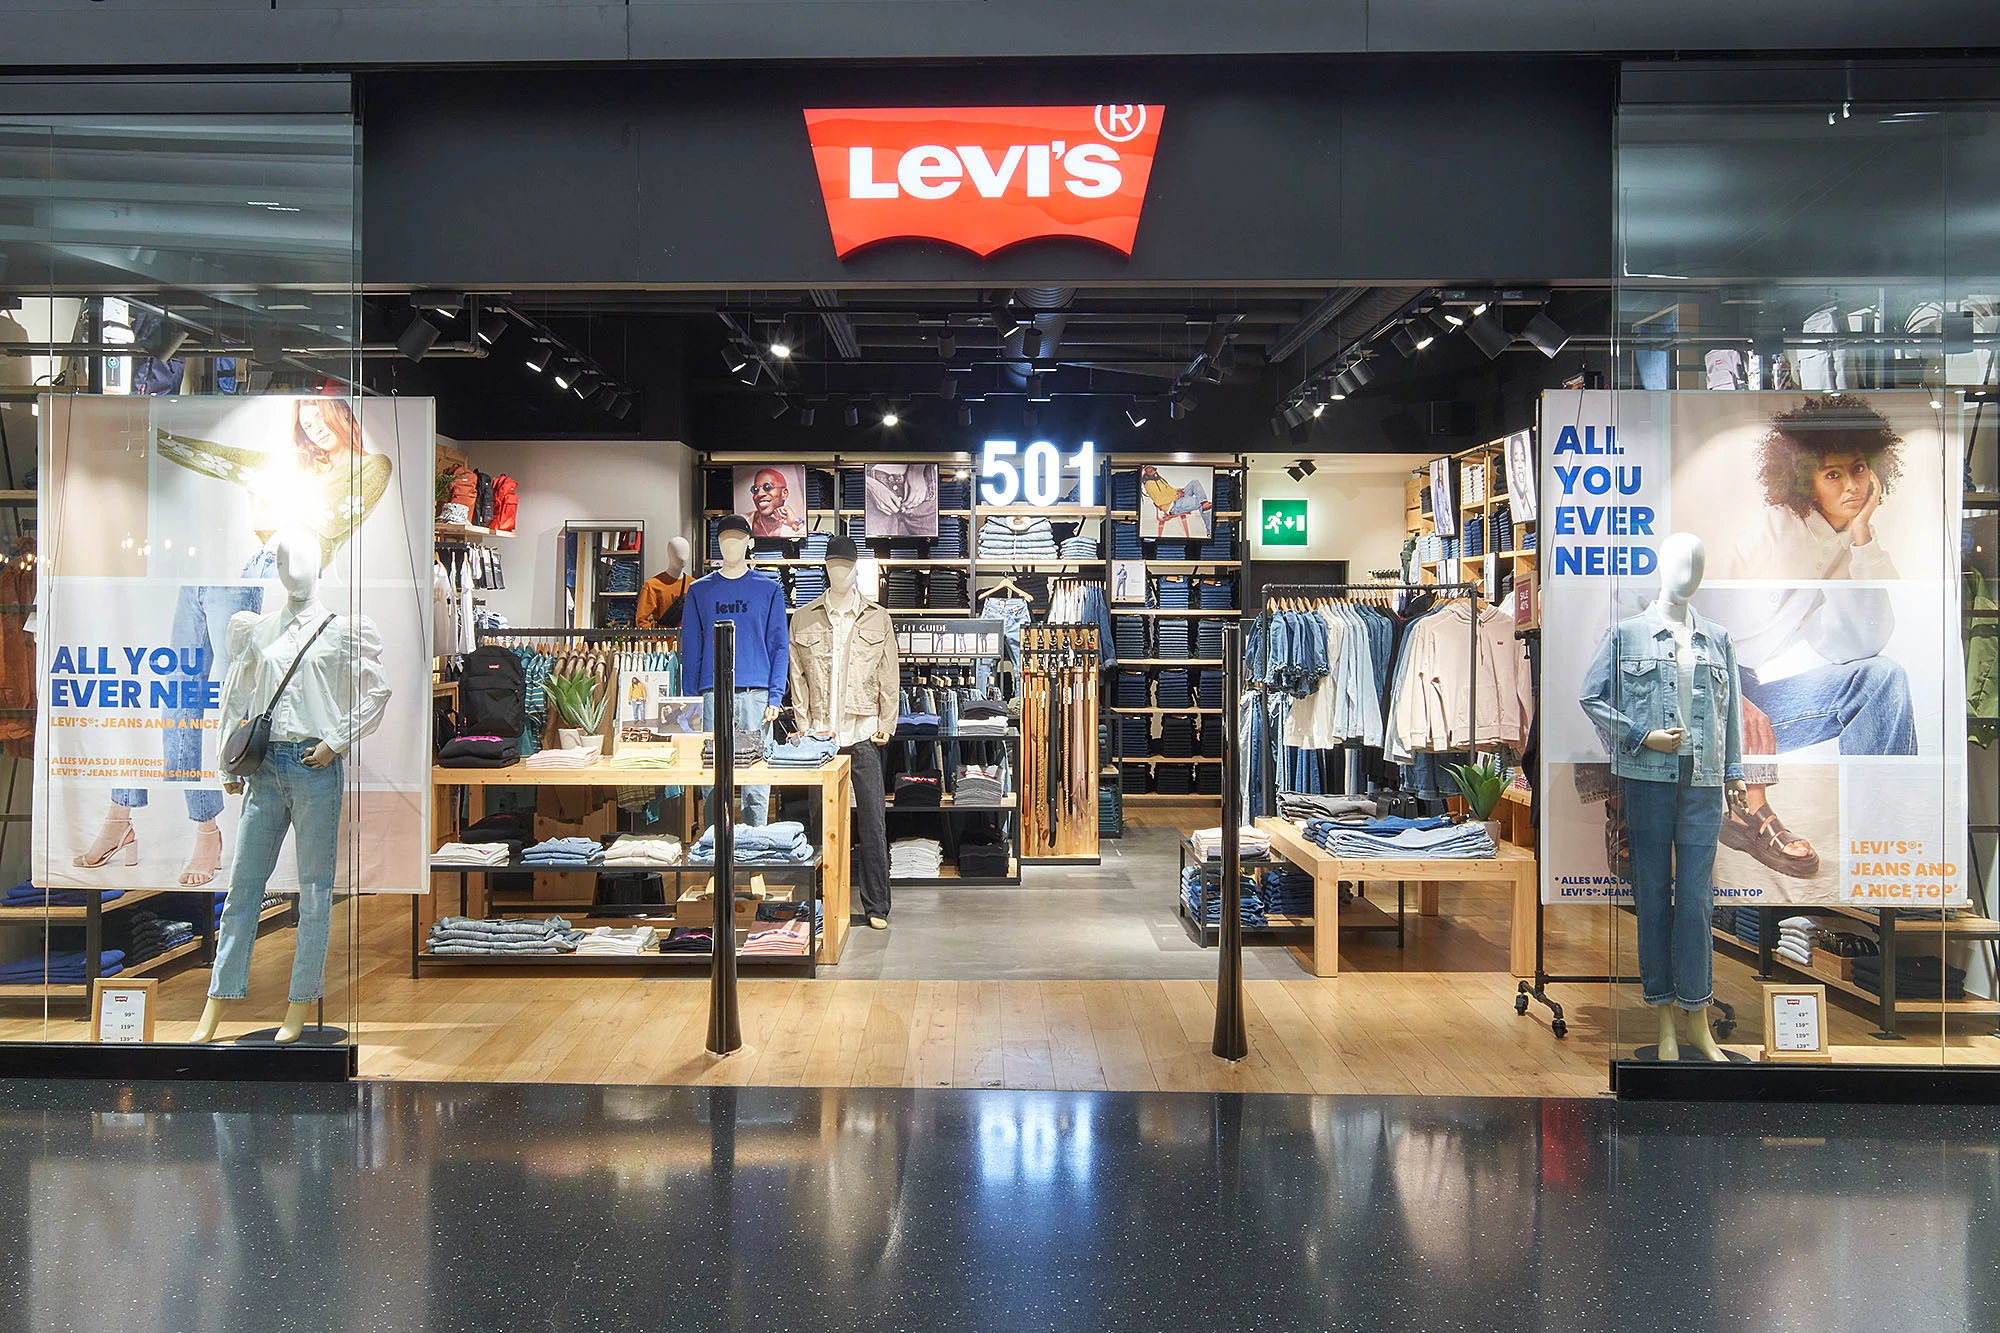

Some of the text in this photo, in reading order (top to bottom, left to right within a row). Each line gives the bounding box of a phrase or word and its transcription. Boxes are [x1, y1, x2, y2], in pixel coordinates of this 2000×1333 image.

[1553, 425, 1625, 455] ALL
[980, 440, 1094, 507] 501
[1553, 465, 1642, 495] YOU
[1555, 506, 1655, 535] EVER
[1555, 546, 1658, 576] NEED
[902, 624, 916, 632] FIT
[919, 624, 948, 632] GUIDE
[50, 646, 204, 676] ALL YOU
[51, 679, 225, 709] EVER NEE
[101, 717, 142, 729] JEANS
[145, 718, 175, 729] AND
[177, 718, 188, 729] A
[189, 719, 219, 729] NICE
[51, 757, 169, 767] ALLES WAS DU BRAUCHST
[87, 768, 119, 777] JEANS
[120, 769, 137, 777] MIT
[139, 769, 167, 778] EINEM
[168, 768, 215, 778] SCHÖNEN
[1850, 862, 1957, 877] JEANS AND
[1561, 876, 1591, 885] ALLES
[1592, 876, 1618, 885] WAS
[1713, 886, 1763, 897] ÖNEN TOP
[1851, 884, 1864, 898] A
[1867, 884, 1912, 898] NICE
